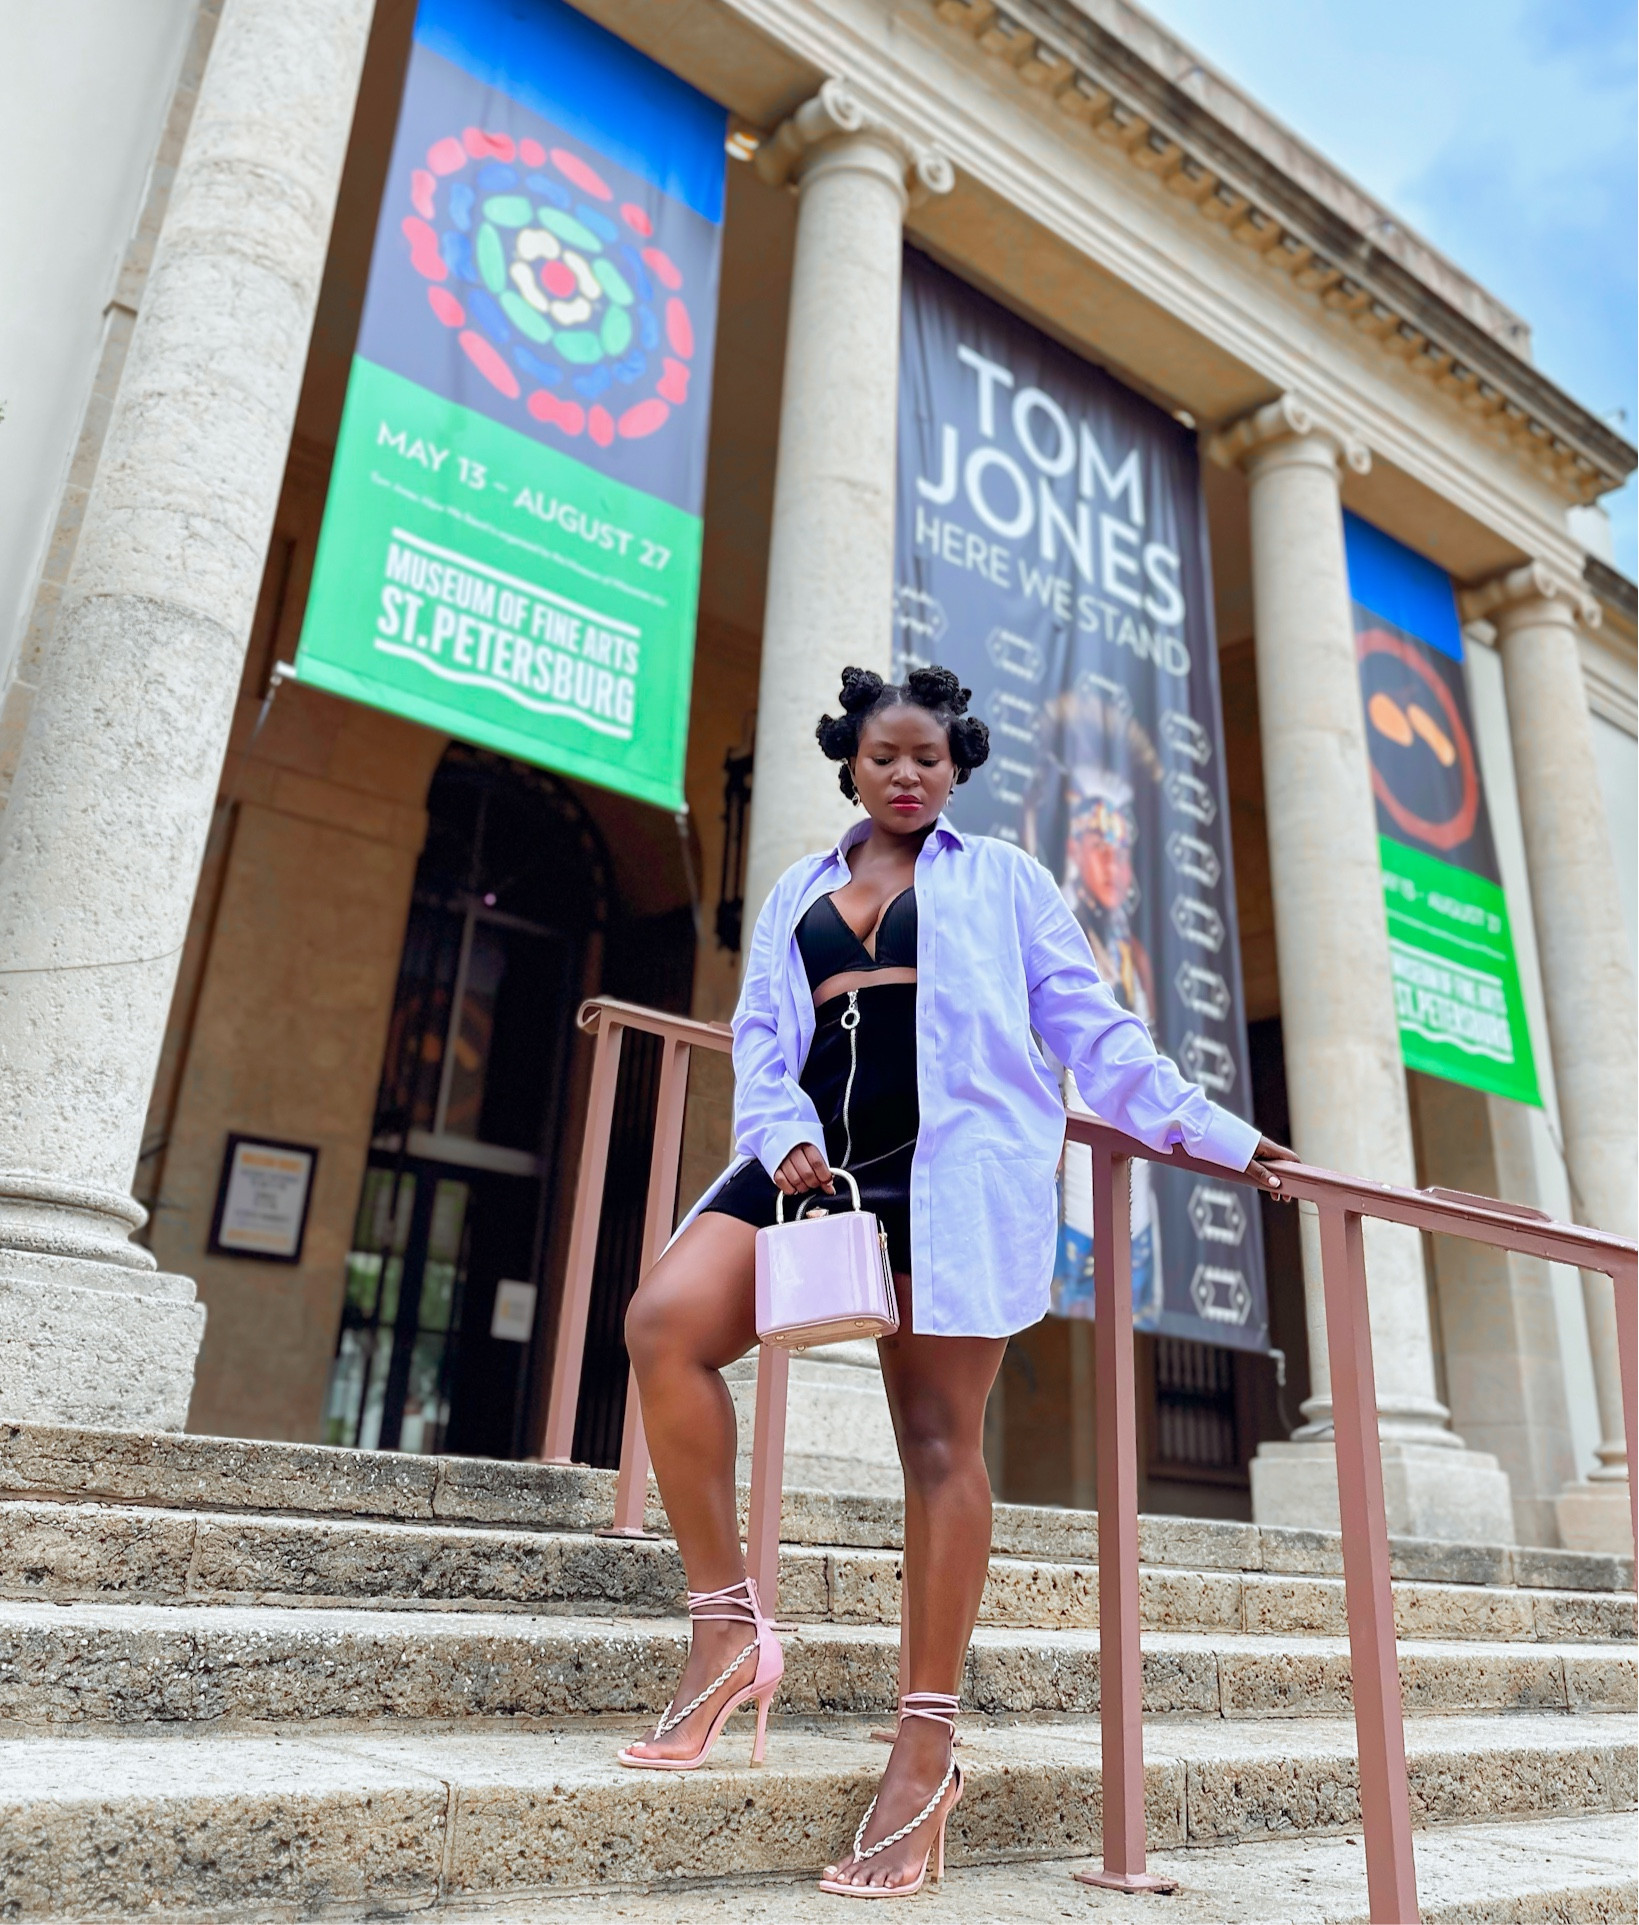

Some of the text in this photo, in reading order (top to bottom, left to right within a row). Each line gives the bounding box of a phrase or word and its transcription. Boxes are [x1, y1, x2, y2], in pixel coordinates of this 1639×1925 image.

[376, 420, 450, 471] MAY
[458, 456, 489, 490] 13
[513, 486, 635, 556] AUGUST
[639, 539, 671, 571] 27
[957, 343, 1146, 528] TOM
[385, 541, 497, 621] MUSEUM
[499, 594, 531, 632] OF
[531, 602, 582, 653] FINE
[583, 622, 640, 676] ARTS
[915, 422, 1186, 626] JONES
[915, 504, 1192, 678] HERE WE STAND
